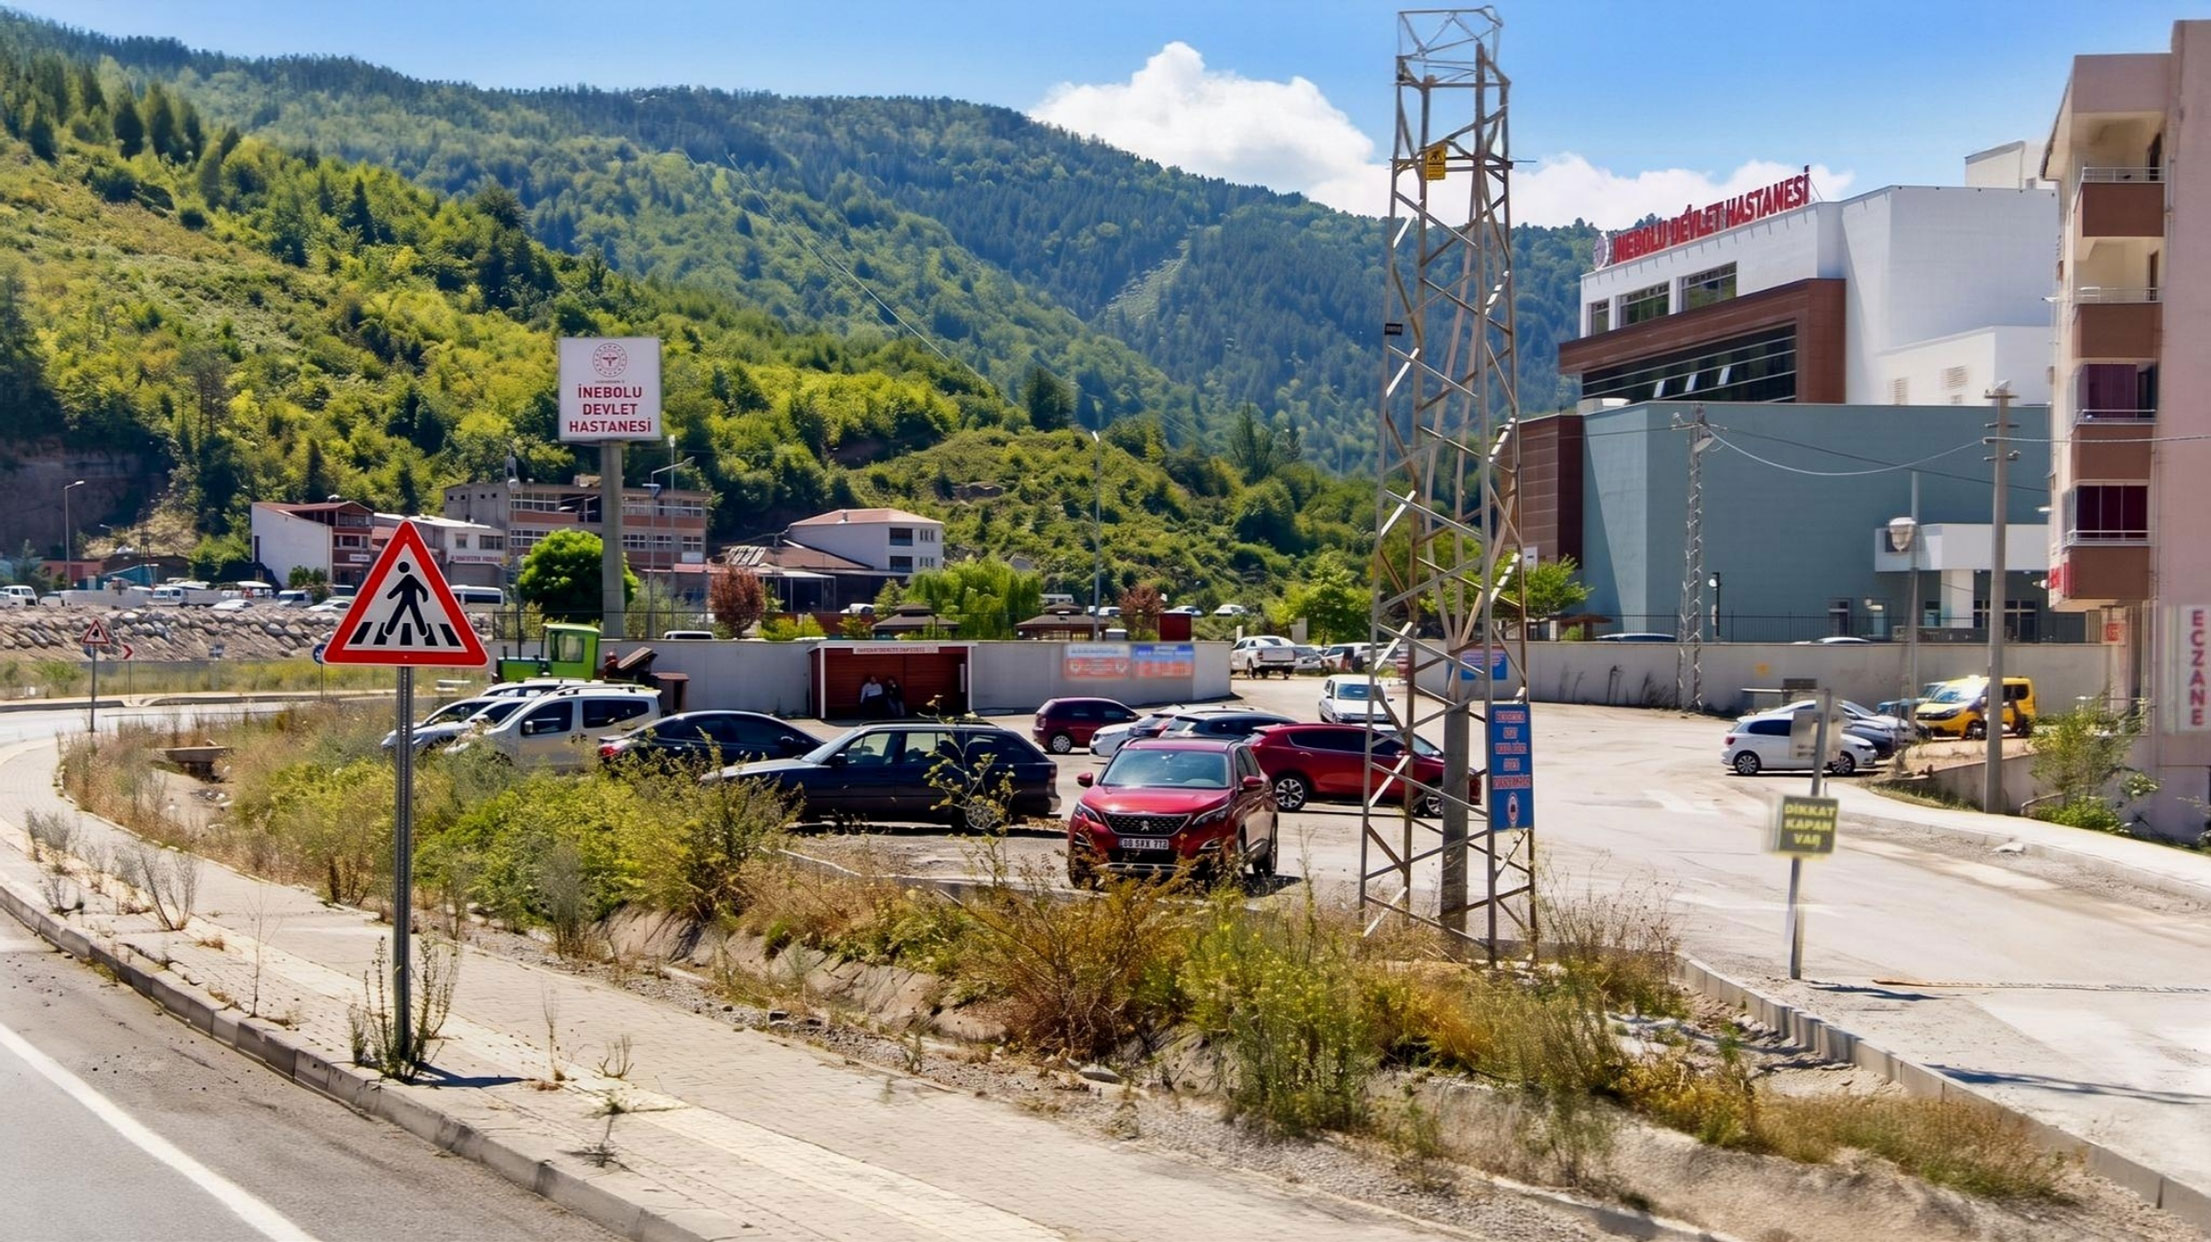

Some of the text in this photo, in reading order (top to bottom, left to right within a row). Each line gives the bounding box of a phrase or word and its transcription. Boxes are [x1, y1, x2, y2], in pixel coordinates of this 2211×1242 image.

[1670, 201, 1725, 248] DEVLET
[1726, 164, 1810, 229] HASTANESİ
[578, 383, 642, 398] İNEBOLU
[583, 403, 638, 415] DEVLET
[569, 417, 652, 432] HASTANESİ
[2190, 610, 2206, 726] ECZANE
[1785, 803, 1836, 816] DİKKAT
[1785, 819, 1832, 831] KAPAN
[1794, 834, 1822, 846] VAR
